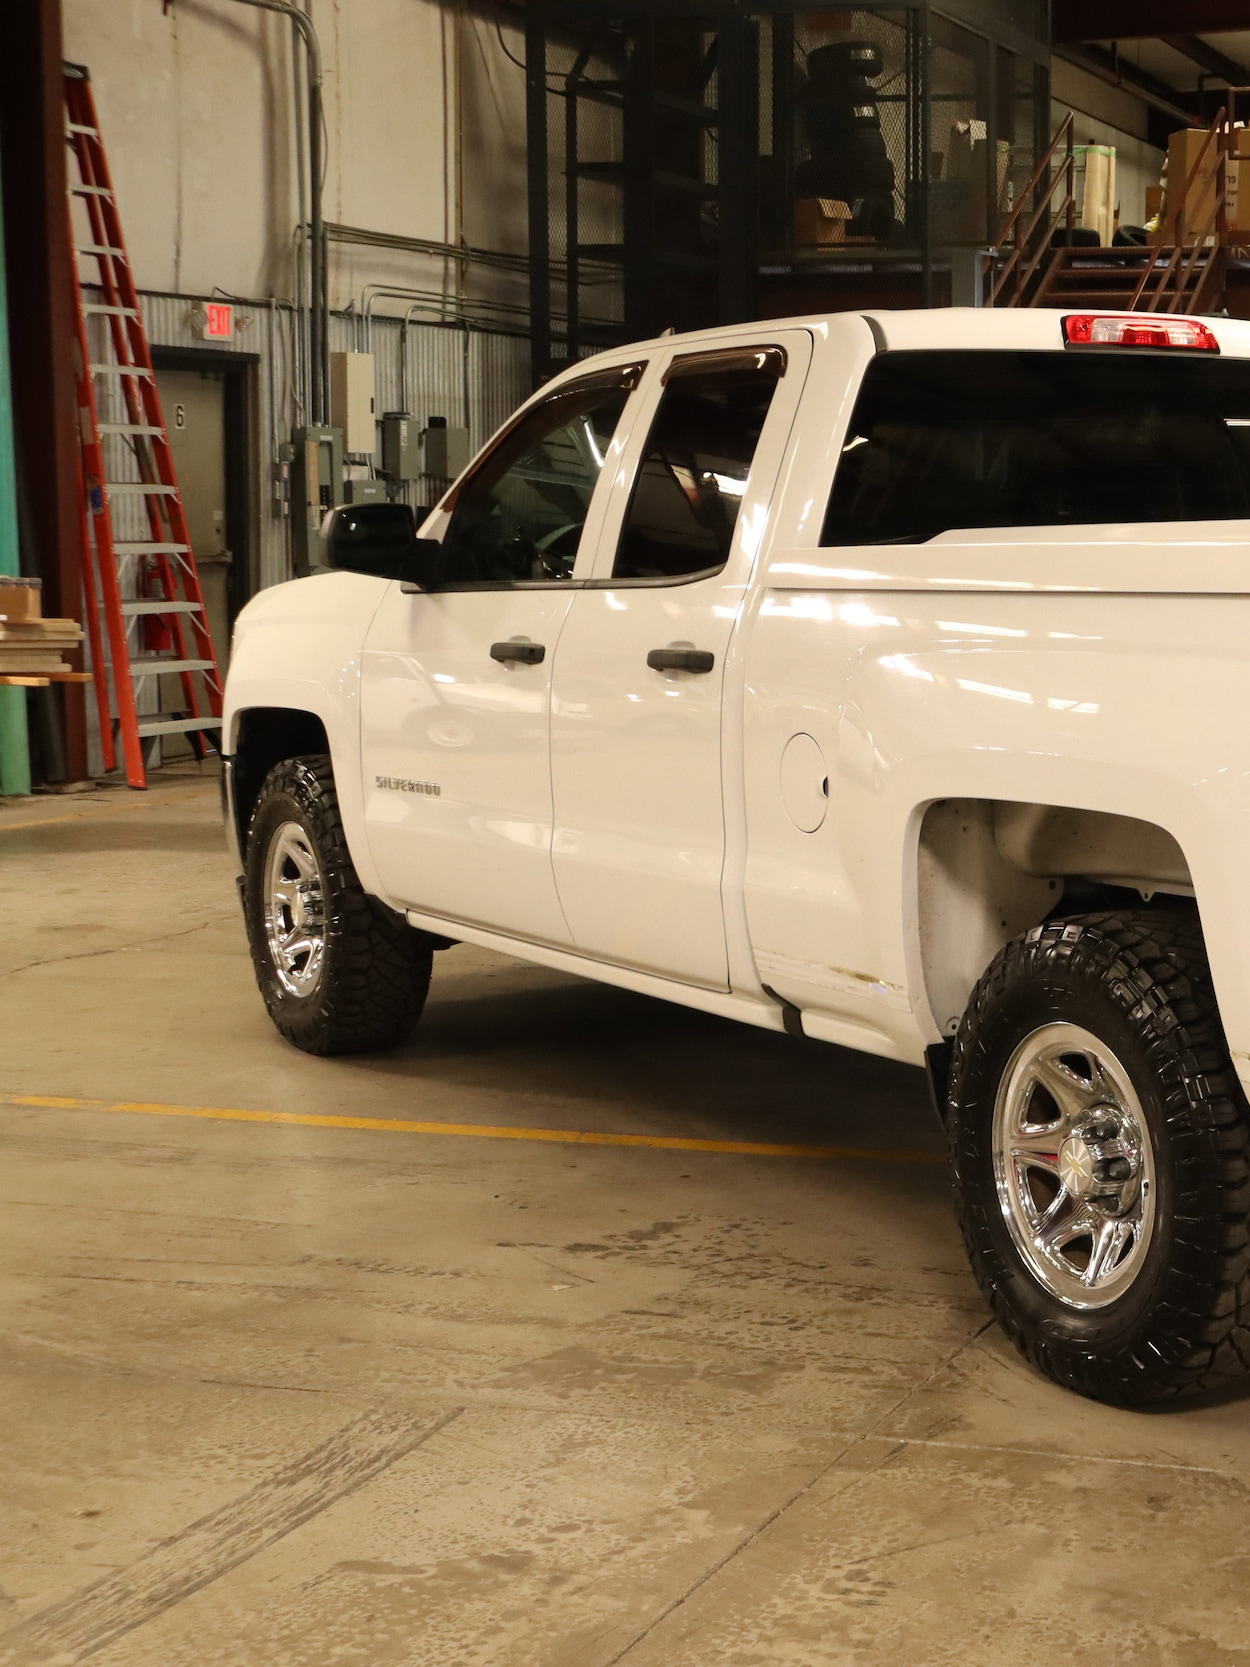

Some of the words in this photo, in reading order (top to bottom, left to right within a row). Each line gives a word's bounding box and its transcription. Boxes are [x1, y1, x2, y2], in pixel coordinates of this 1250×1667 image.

[207, 304, 231, 336] EXIT
[176, 404, 184, 428] 6
[375, 776, 441, 796] SILVERADO
